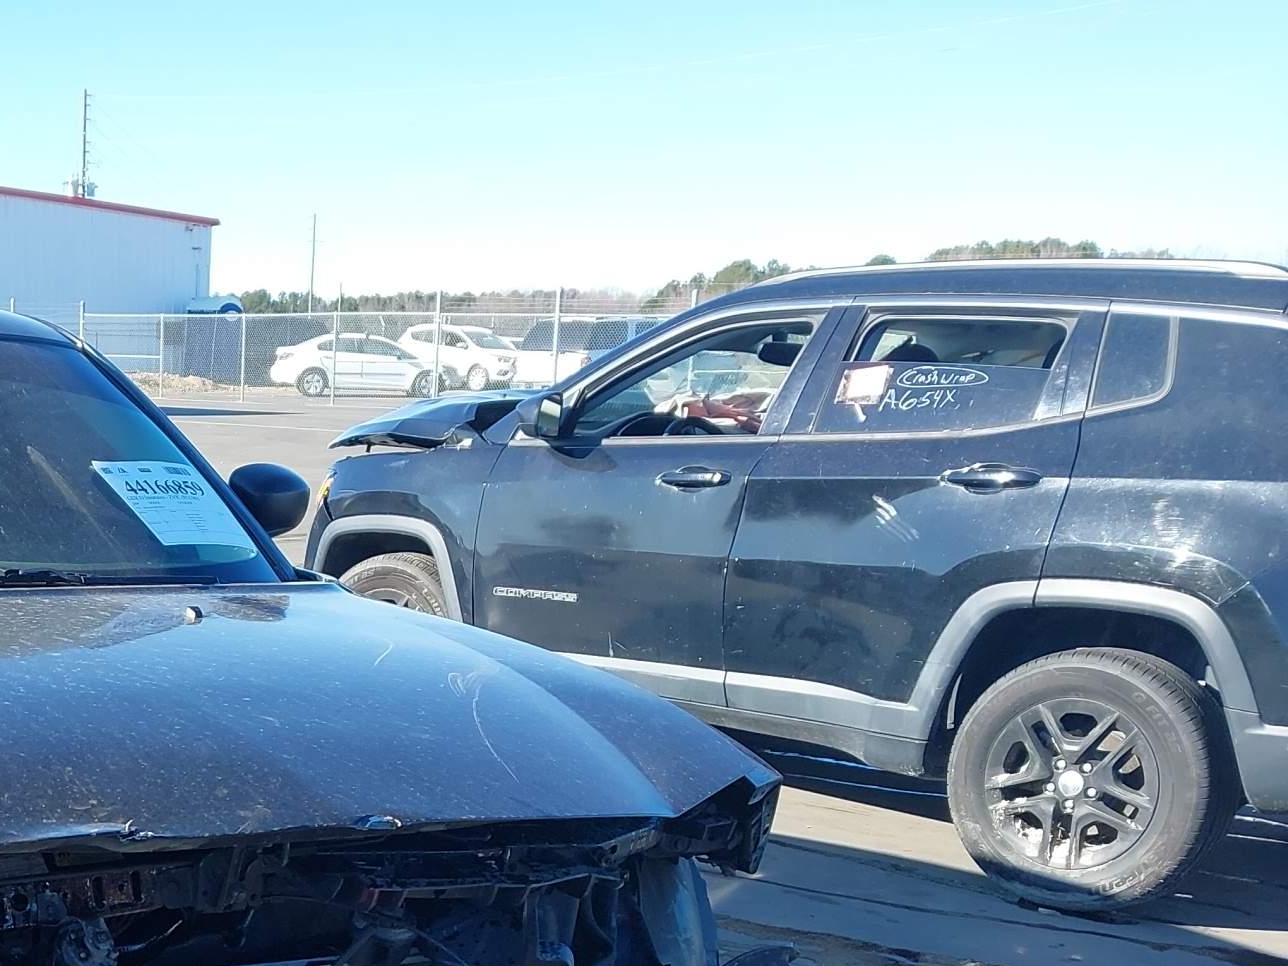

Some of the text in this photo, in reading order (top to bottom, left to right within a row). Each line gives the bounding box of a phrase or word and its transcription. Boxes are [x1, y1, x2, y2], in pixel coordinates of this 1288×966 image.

[902, 370, 938, 385] Crash
[124, 479, 205, 496] 44166859
[492, 586, 578, 602] COMPASS
